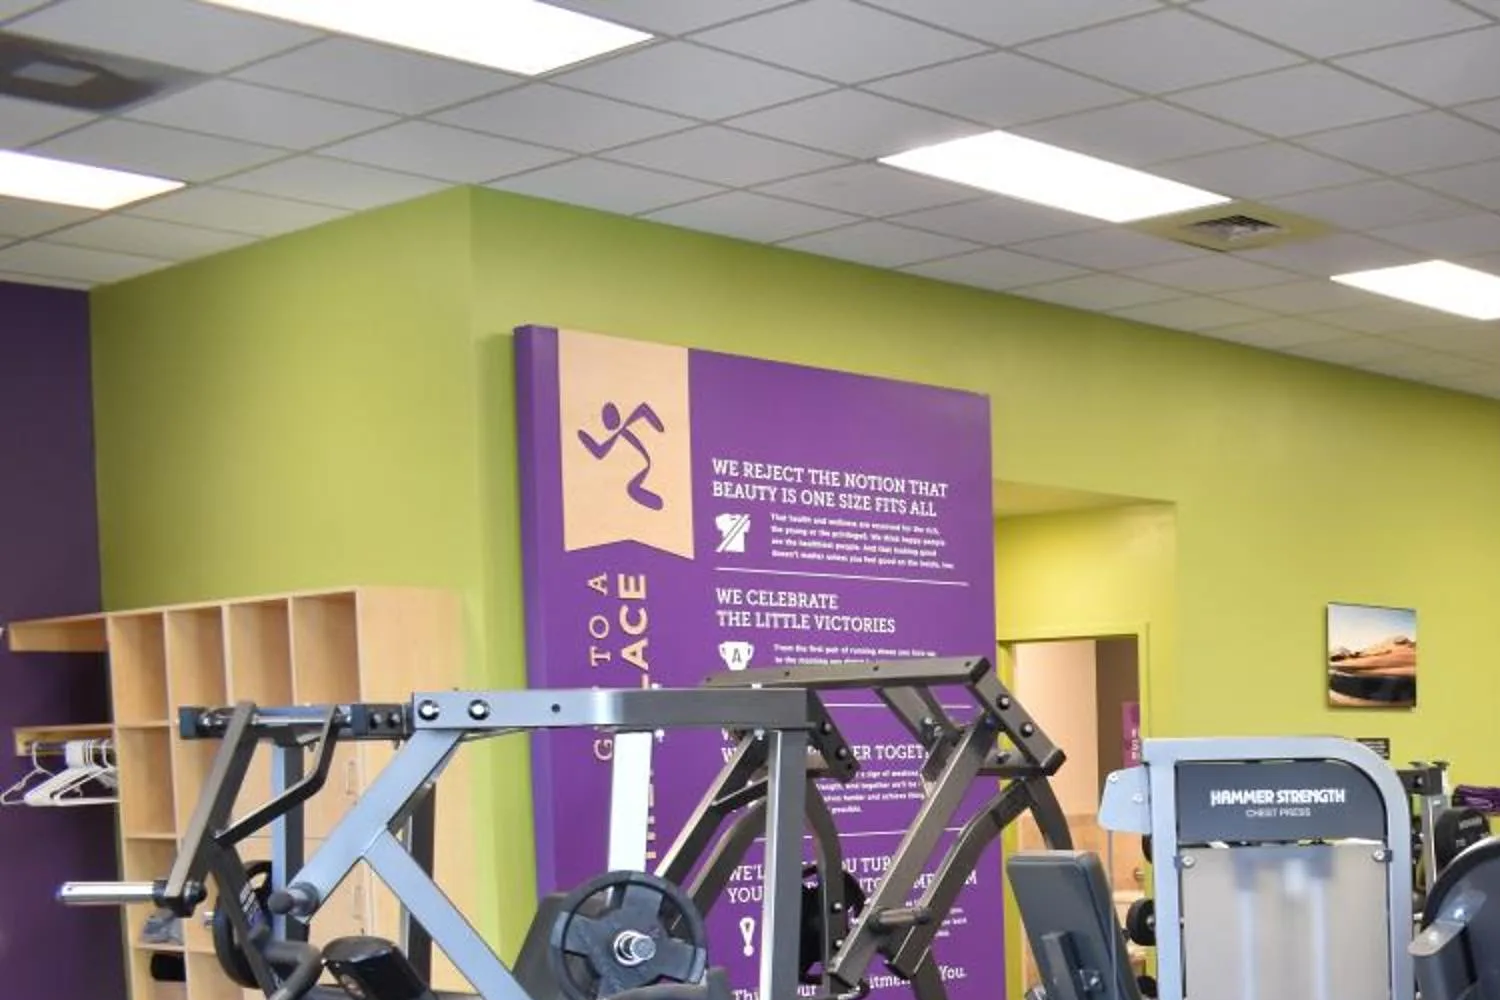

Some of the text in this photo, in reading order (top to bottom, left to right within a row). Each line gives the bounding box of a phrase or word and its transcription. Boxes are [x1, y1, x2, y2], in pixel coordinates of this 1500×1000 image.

[712, 458, 948, 497] WE REJECT THE NOTION THAT
[712, 481, 937, 517] BEAUTY IS ONE SIZE FITS ALL
[587, 572, 608, 595] A
[716, 588, 839, 610] WE CELEBRATE
[617, 573, 649, 691] ACE
[716, 611, 895, 633] THE LITTLE VICTORIES
[589, 614, 612, 667] TO
[874, 744, 927, 760] TOGET
[1210, 788, 1346, 806] HAMMER STRENGTH
[1246, 807, 1311, 818] CHEST PRESS
[730, 864, 765, 881] WE'L
[861, 856, 892, 873] TUR
[727, 886, 765, 904] YOU
